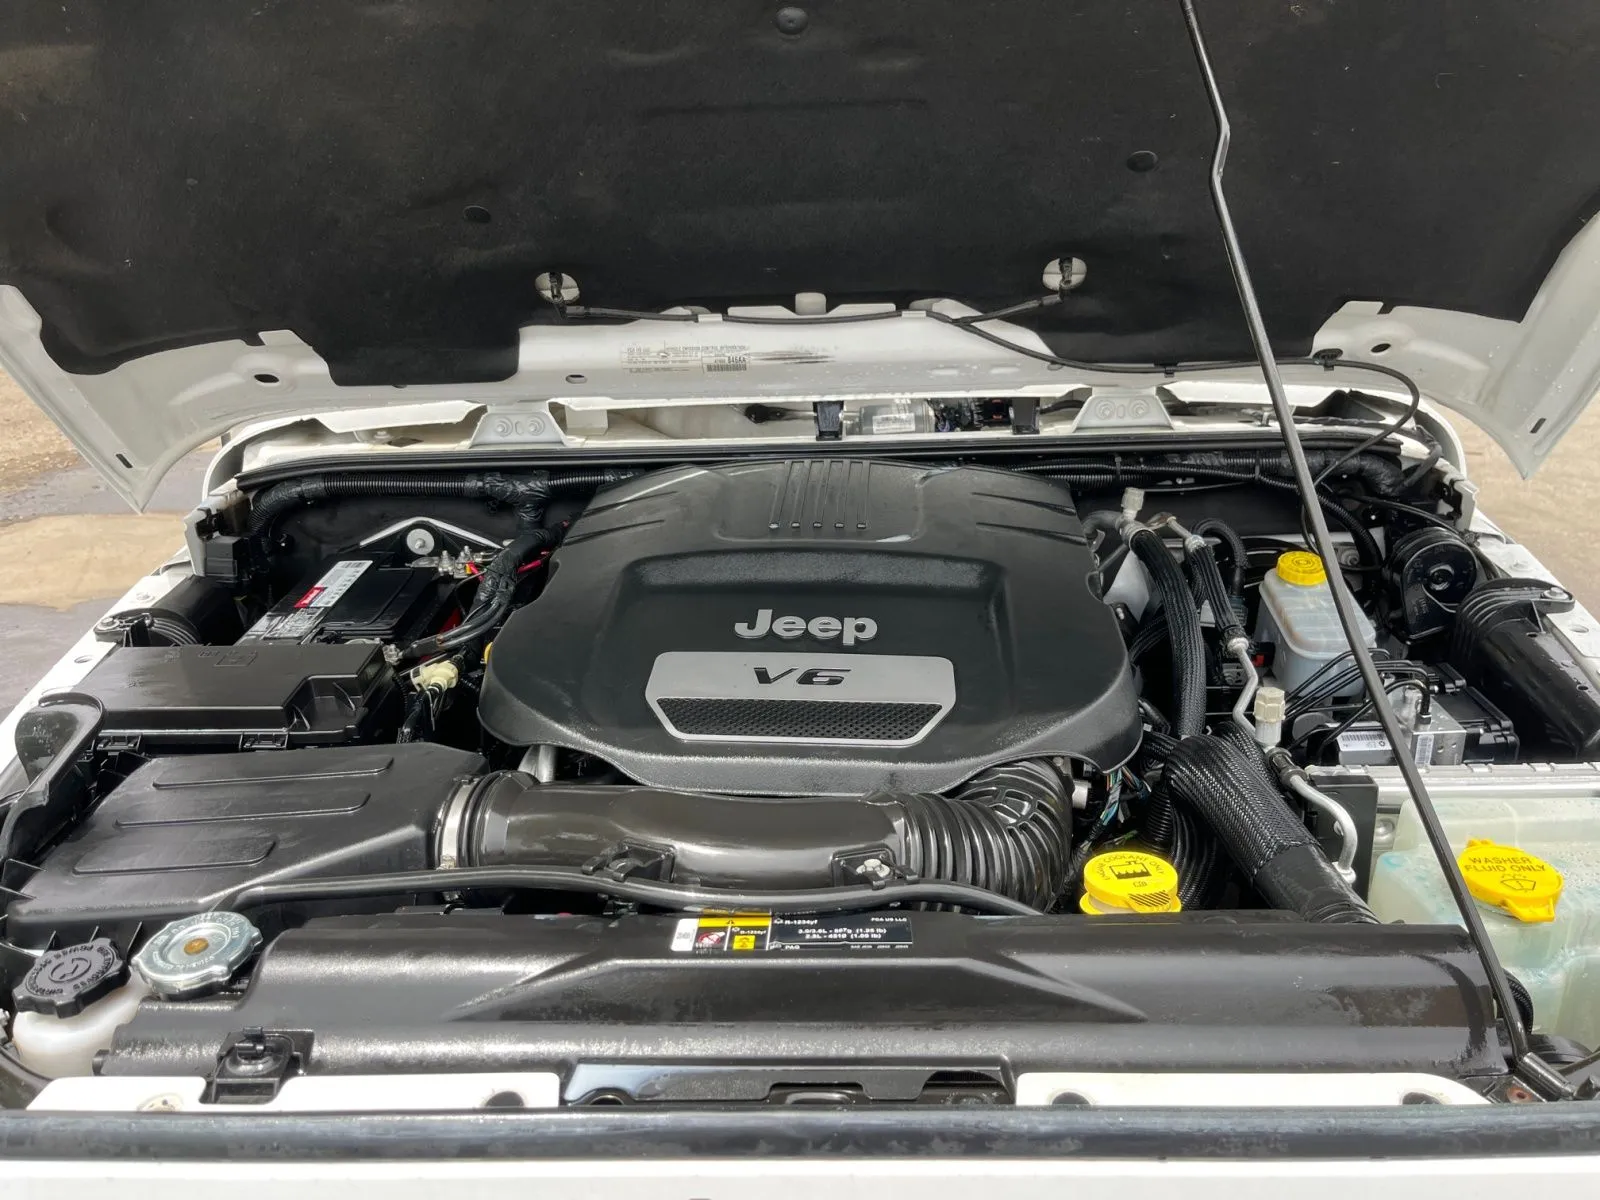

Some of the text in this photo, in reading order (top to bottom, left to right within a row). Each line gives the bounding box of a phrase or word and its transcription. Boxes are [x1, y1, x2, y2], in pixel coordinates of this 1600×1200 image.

[734, 609, 878, 646] Jeep
[754, 667, 852, 685] V6
[1103, 854, 1149, 863] COOLANT
[1510, 864, 1545, 872] ONLY
